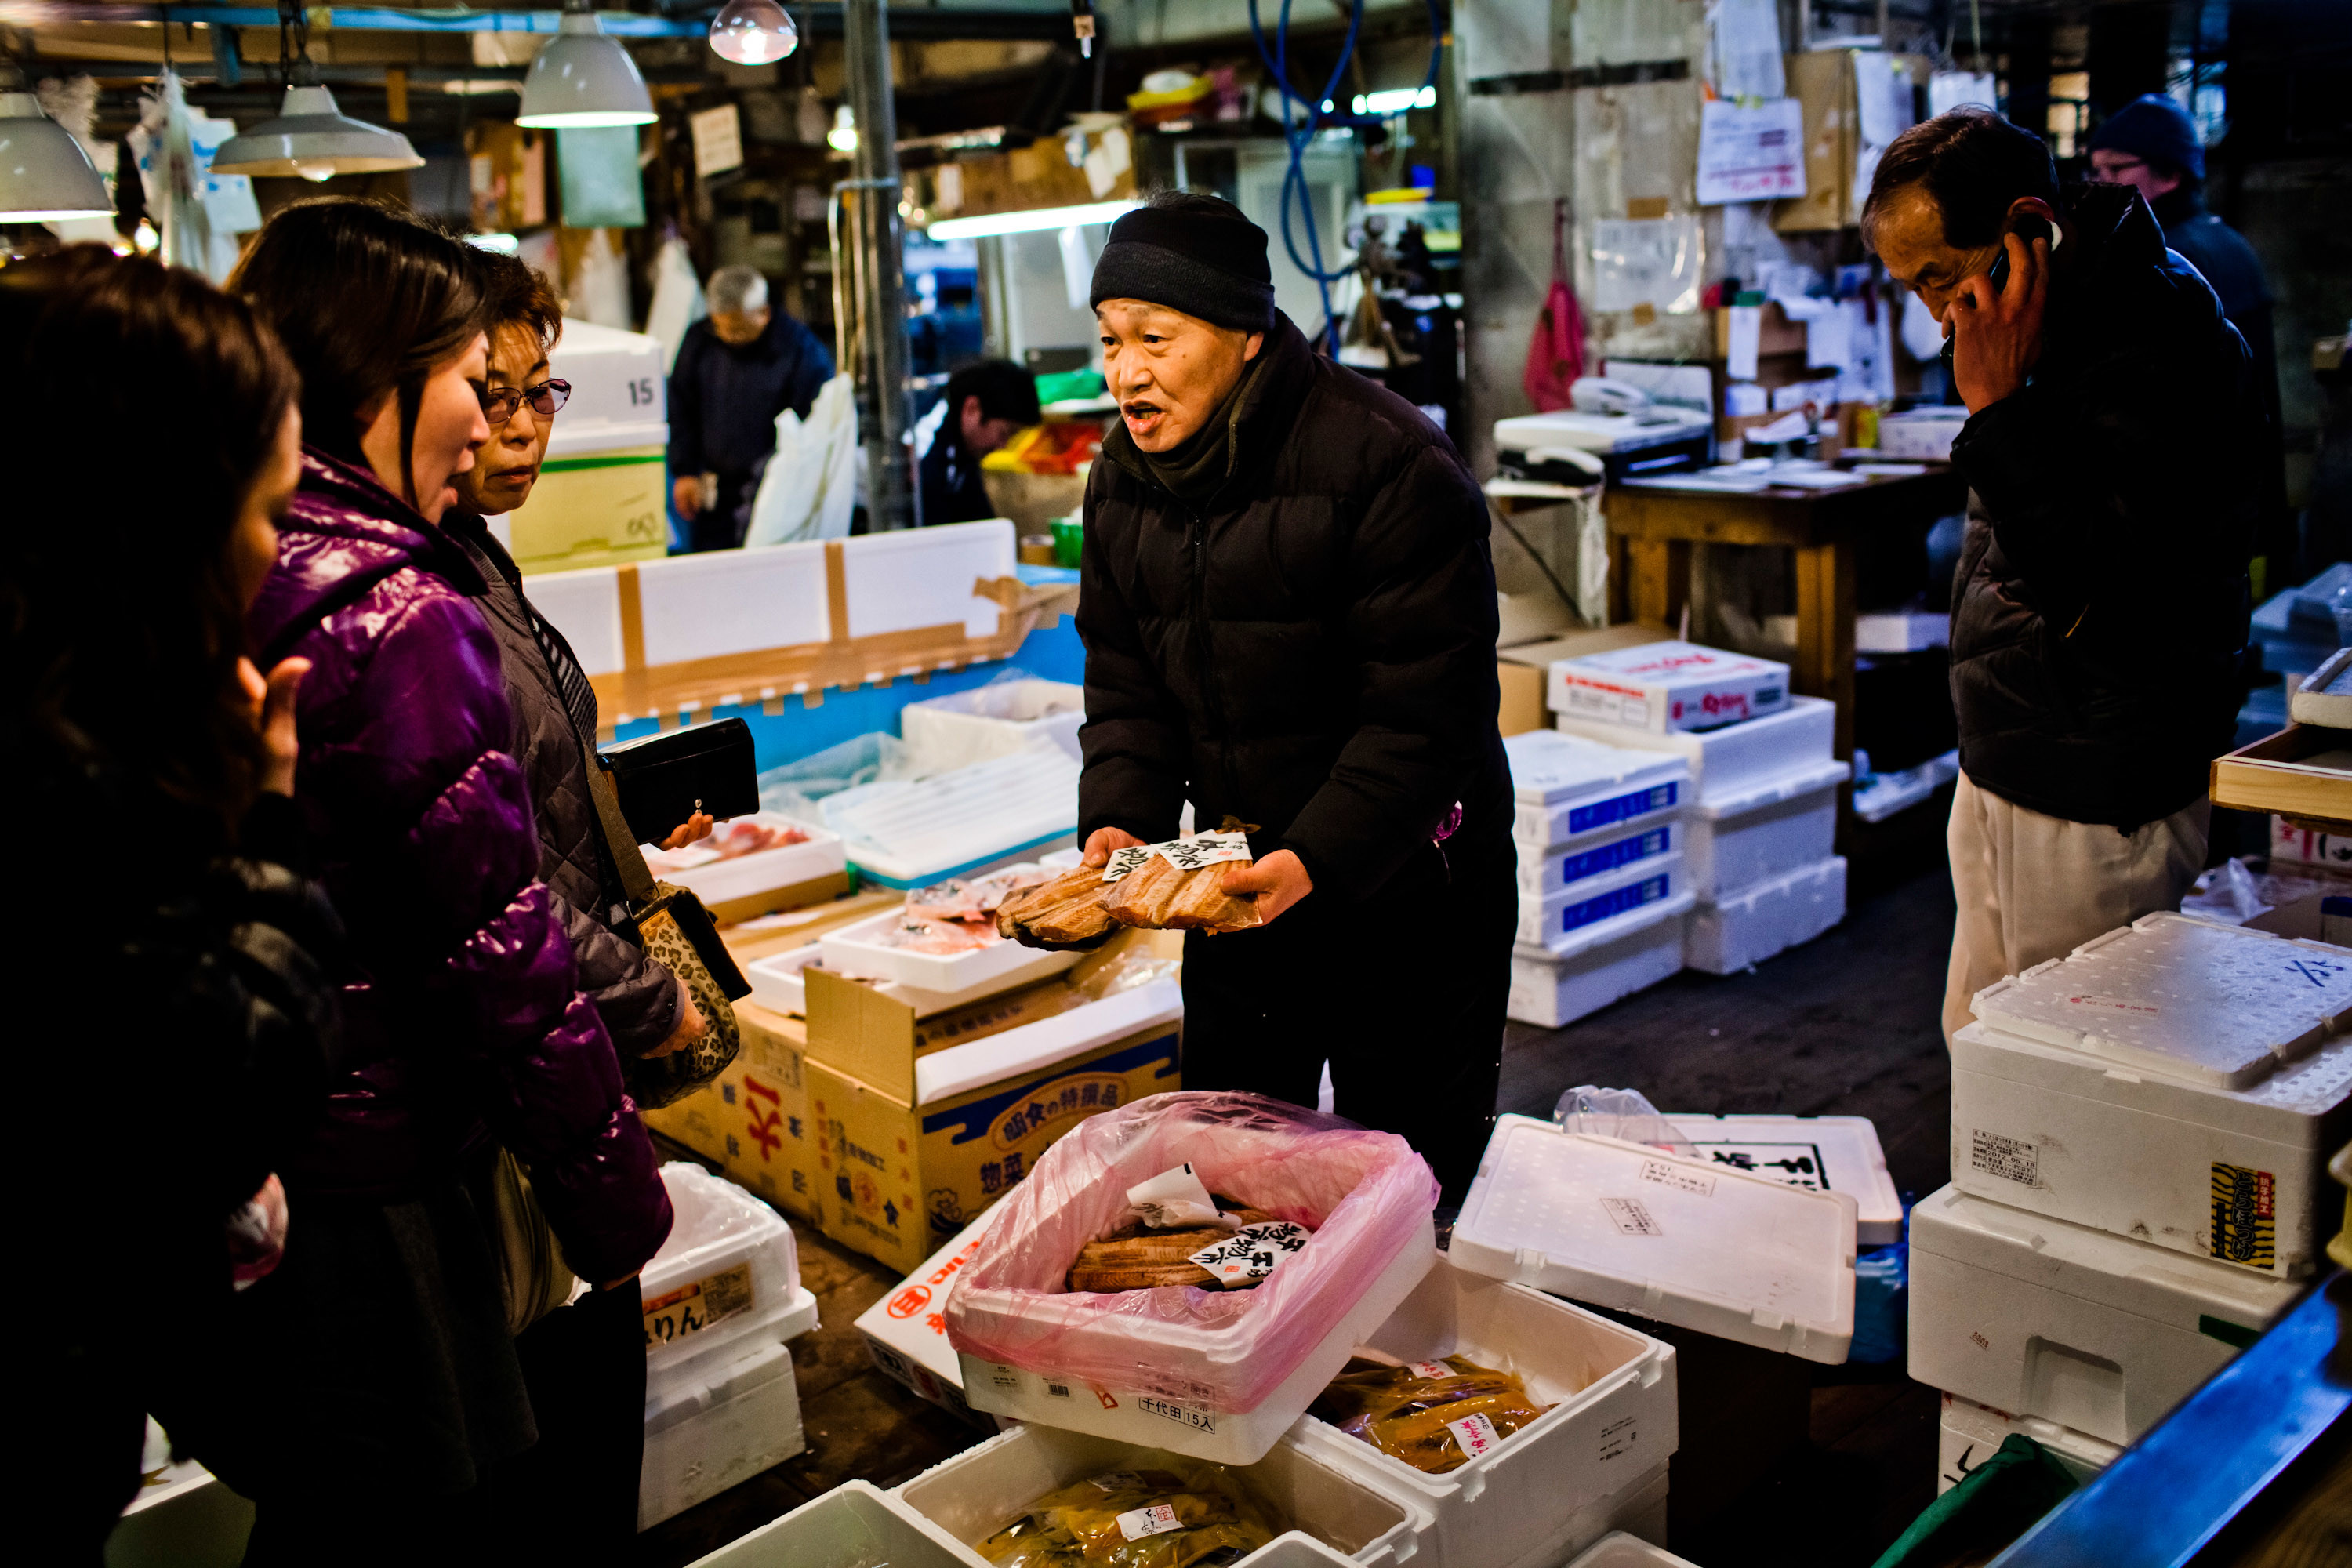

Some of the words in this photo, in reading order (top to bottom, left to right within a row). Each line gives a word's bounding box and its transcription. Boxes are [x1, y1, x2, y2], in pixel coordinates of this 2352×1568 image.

[629, 379, 653, 406] 15
[645, 1306, 704, 1343] りん
[1142, 1398, 1181, 1419] 千代田
[1186, 1411, 1213, 1432] 15入
